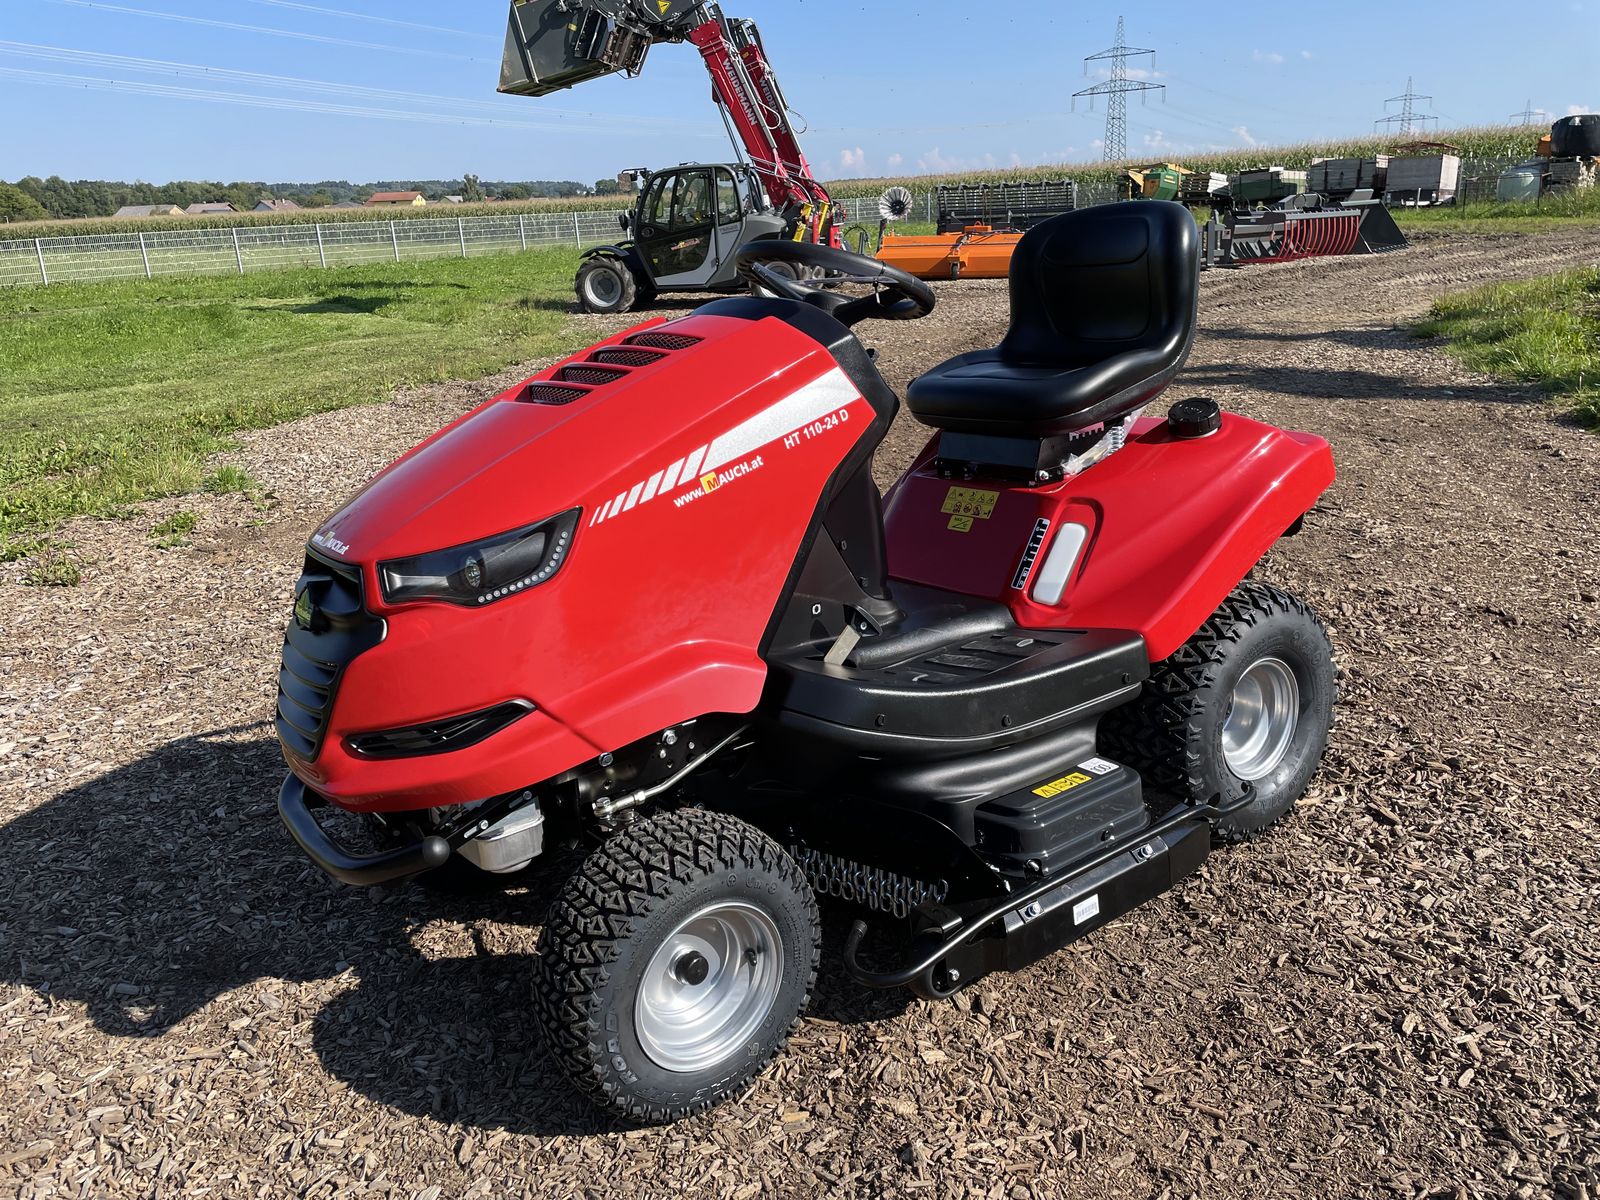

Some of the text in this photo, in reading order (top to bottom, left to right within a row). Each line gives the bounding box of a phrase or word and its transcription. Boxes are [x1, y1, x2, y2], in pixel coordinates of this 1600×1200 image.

[722, 58, 758, 126] WEIDEMANN
[783, 409, 849, 450] HT 110-24 D
[673, 455, 764, 507] www.MAUCH.at
